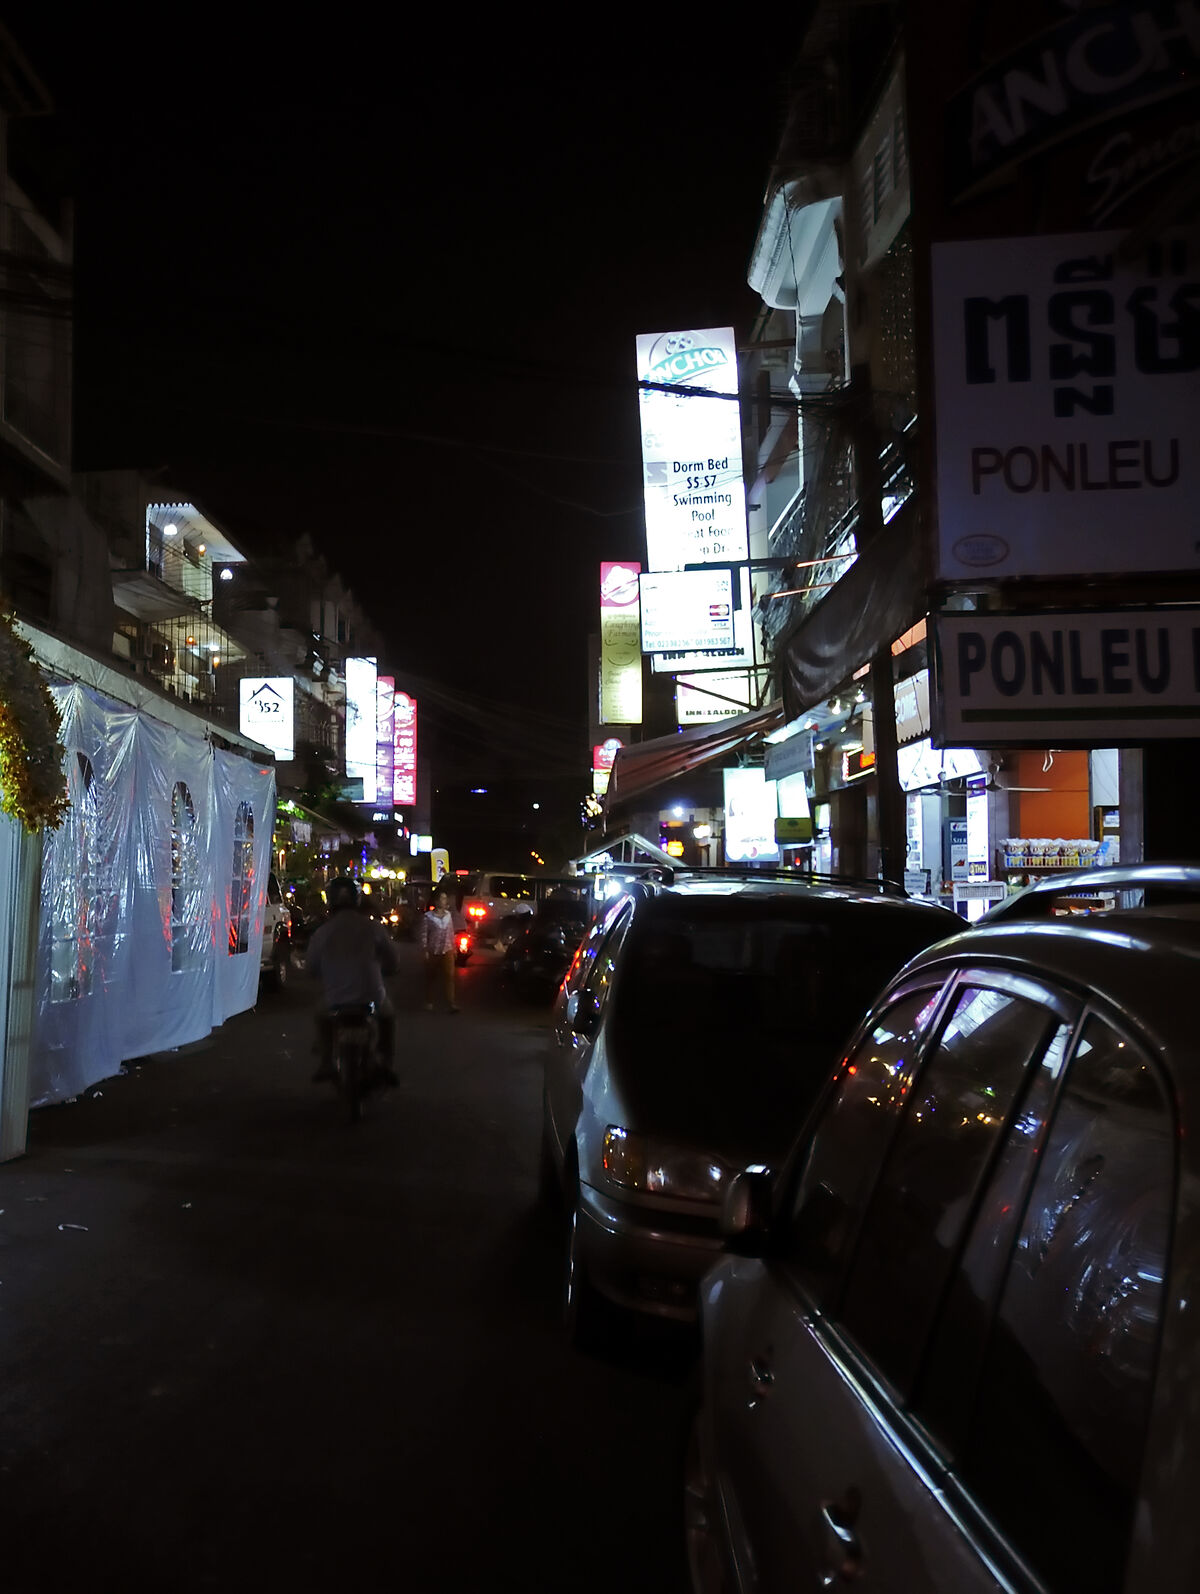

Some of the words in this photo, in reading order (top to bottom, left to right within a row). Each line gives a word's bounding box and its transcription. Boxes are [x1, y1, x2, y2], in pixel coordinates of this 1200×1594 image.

[673, 460, 704, 474] Dorm
[707, 456, 729, 471] Bed
[971, 438, 1180, 495] PONLEU
[673, 491, 732, 507] Swimming
[691, 508, 715, 522] Pool
[957, 627, 1171, 697] PONLEU
